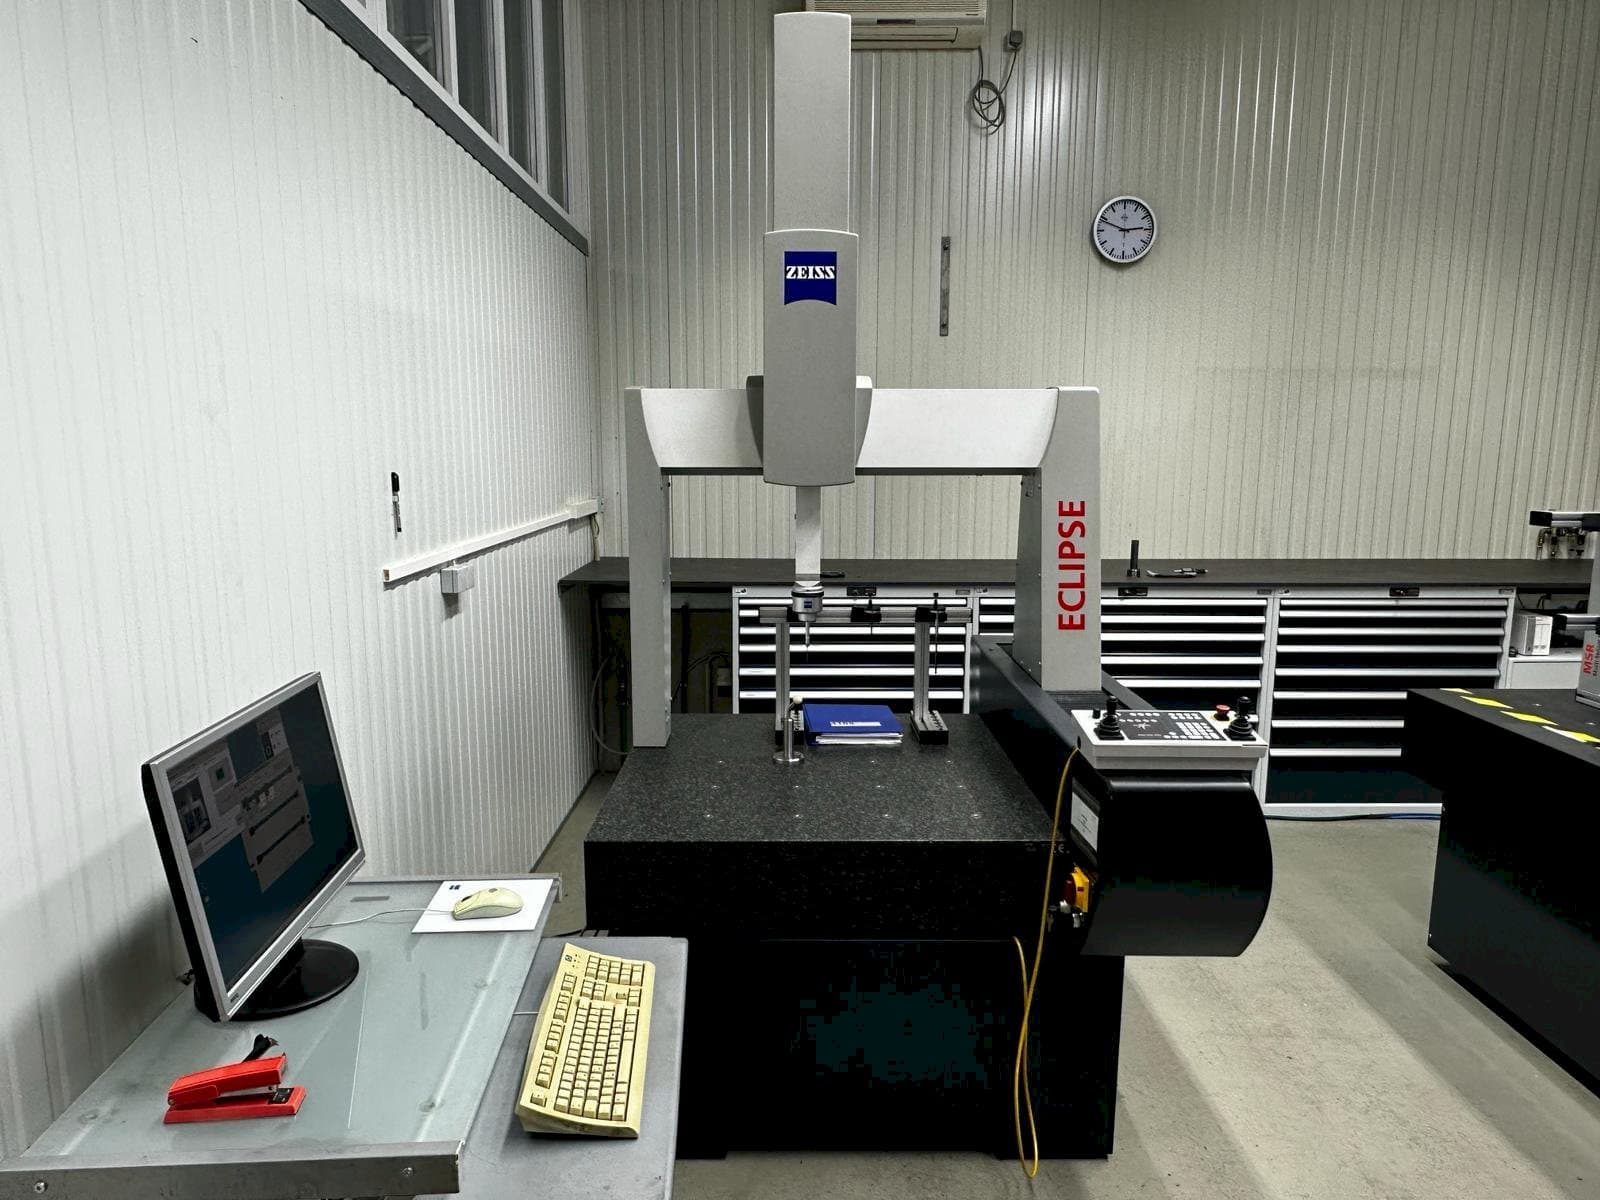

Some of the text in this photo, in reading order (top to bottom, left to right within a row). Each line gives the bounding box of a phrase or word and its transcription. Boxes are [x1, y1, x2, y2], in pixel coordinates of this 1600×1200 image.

[786, 265, 835, 280] ZEISS
[1057, 500, 1086, 631] ECLIPSE
[1583, 643, 1595, 675] MSR
